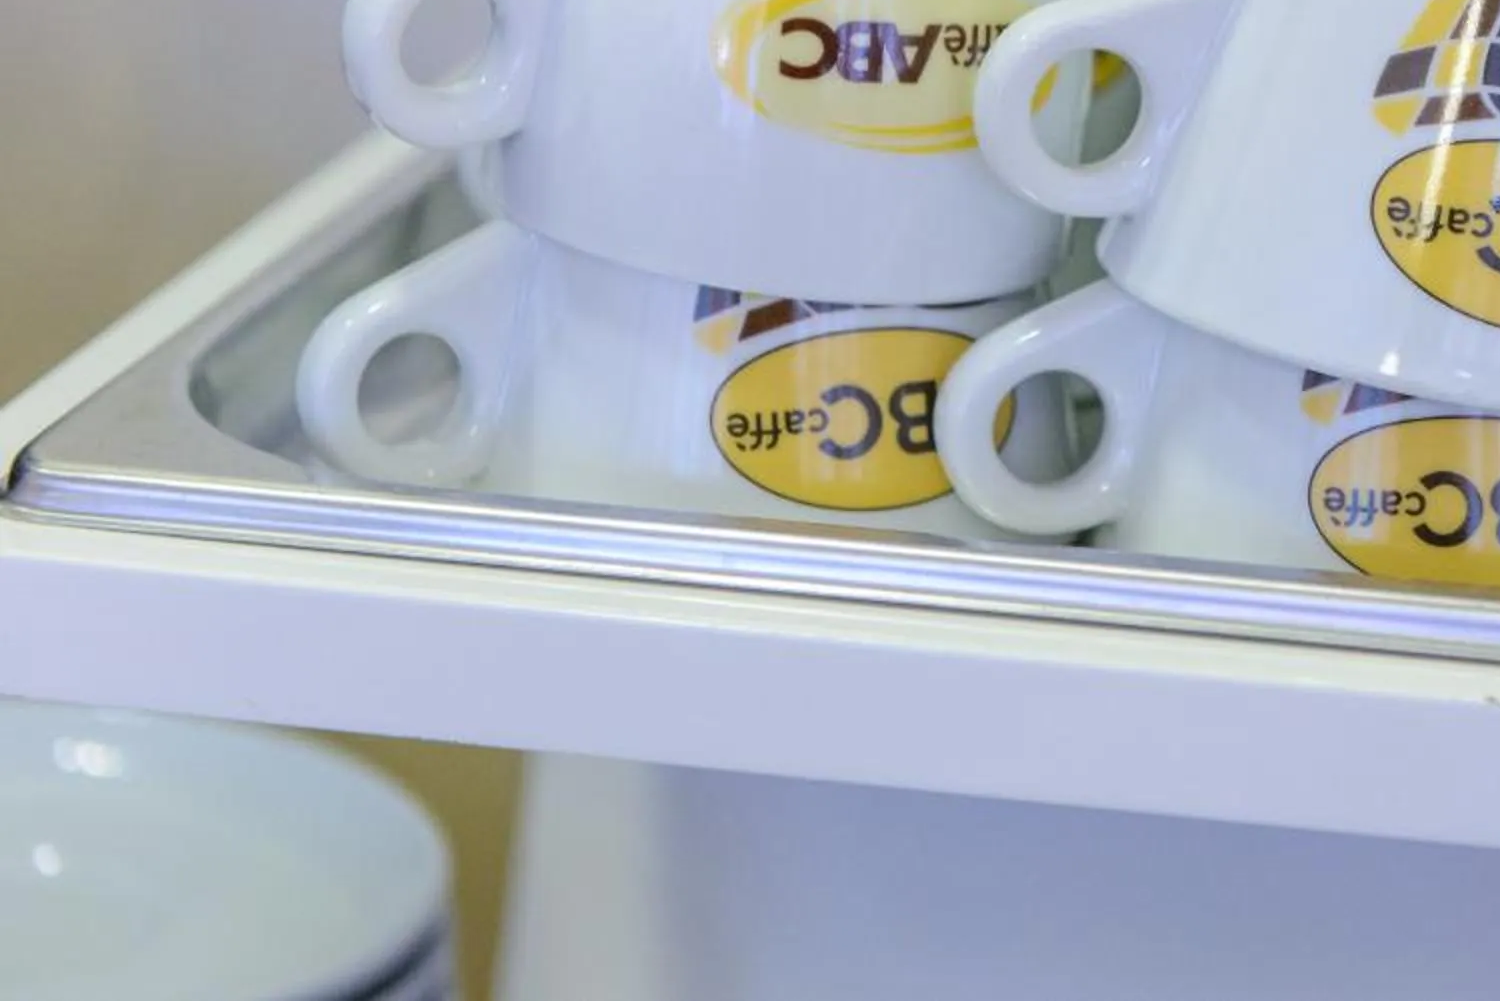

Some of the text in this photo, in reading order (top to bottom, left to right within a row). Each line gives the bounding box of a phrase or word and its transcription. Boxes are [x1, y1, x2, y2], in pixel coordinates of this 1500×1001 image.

[778, 17, 1011, 85] ffè ABC
[727, 379, 938, 461] BC caffè
[1323, 485, 1427, 527] caffè
